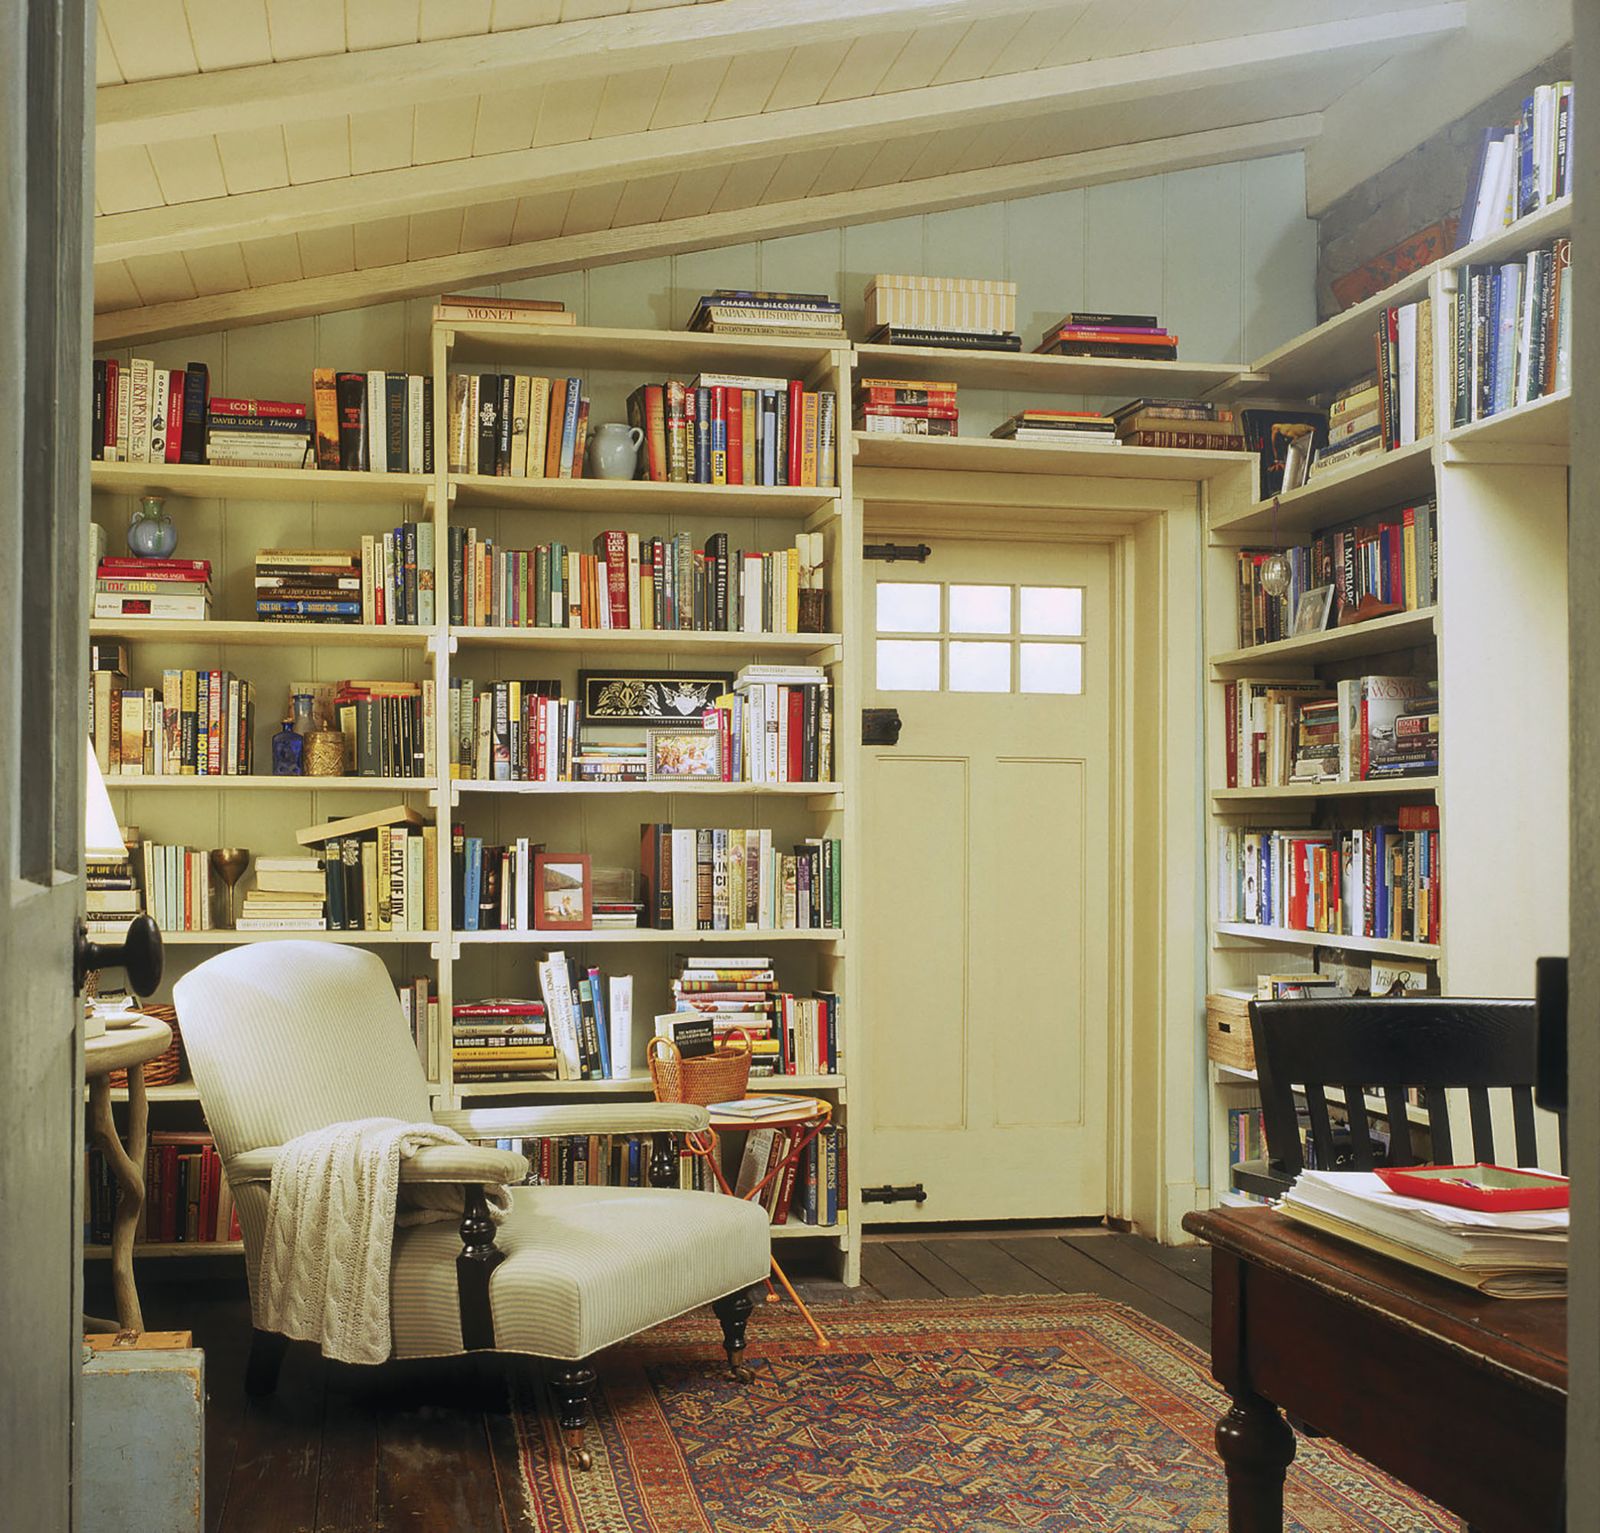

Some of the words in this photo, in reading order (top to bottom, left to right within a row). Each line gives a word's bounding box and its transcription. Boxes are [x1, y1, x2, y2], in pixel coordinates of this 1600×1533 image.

[1549, 245, 1558, 321] REMBRANDT
[467, 308, 516, 321] MONET
[720, 299, 760, 308] CHAGALL
[763, 301, 818, 311] DISCOVERED
[716, 308, 748, 319] JAPAN
[749, 309, 757, 319] A
[758, 310, 801, 322] HISTORY
[802, 312, 812, 322] IN
[814, 314, 832, 324] ART
[1457, 293, 1466, 355] CISTERCIAN
[1380, 342, 1389, 379] Family
[133, 368, 149, 383] THE
[1457, 356, 1466, 397] ABBEYS
[569, 380, 578, 404] JOHN
[230, 403, 248, 411] ECO
[1383, 380, 1391, 437] Collections
[212, 417, 237, 425] DAVID
[238, 418, 264, 426] LODGE
[269, 420, 298, 429] Therapy
[805, 428, 815, 454] DRAMA
[1345, 547, 1354, 606] MATRIARC
[107, 581, 127, 591] mr.
[128, 581, 157, 592] mike
[198, 678, 208, 697] JANET
[210, 677, 220, 692] JANET
[197, 733, 208, 754] HOT
[209, 737, 220, 753] HIGH
[197, 755, 208, 771] SIX
[209, 754, 219, 768] FIVE
[627, 765, 645, 773] UBAR
[594, 774, 623, 782] SPOOK
[382, 830, 390, 852] ETHAN
[382, 852, 390, 876] HAWKE
[390, 849, 404, 878] CITY
[390, 879, 404, 895] OF
[390, 897, 404, 917] JOY
[545, 968, 554, 992] VINCI
[455, 1038, 486, 1047] ELMORE
[508, 1037, 544, 1046] LEONARD
[828, 1152, 836, 1190] PERKINS
